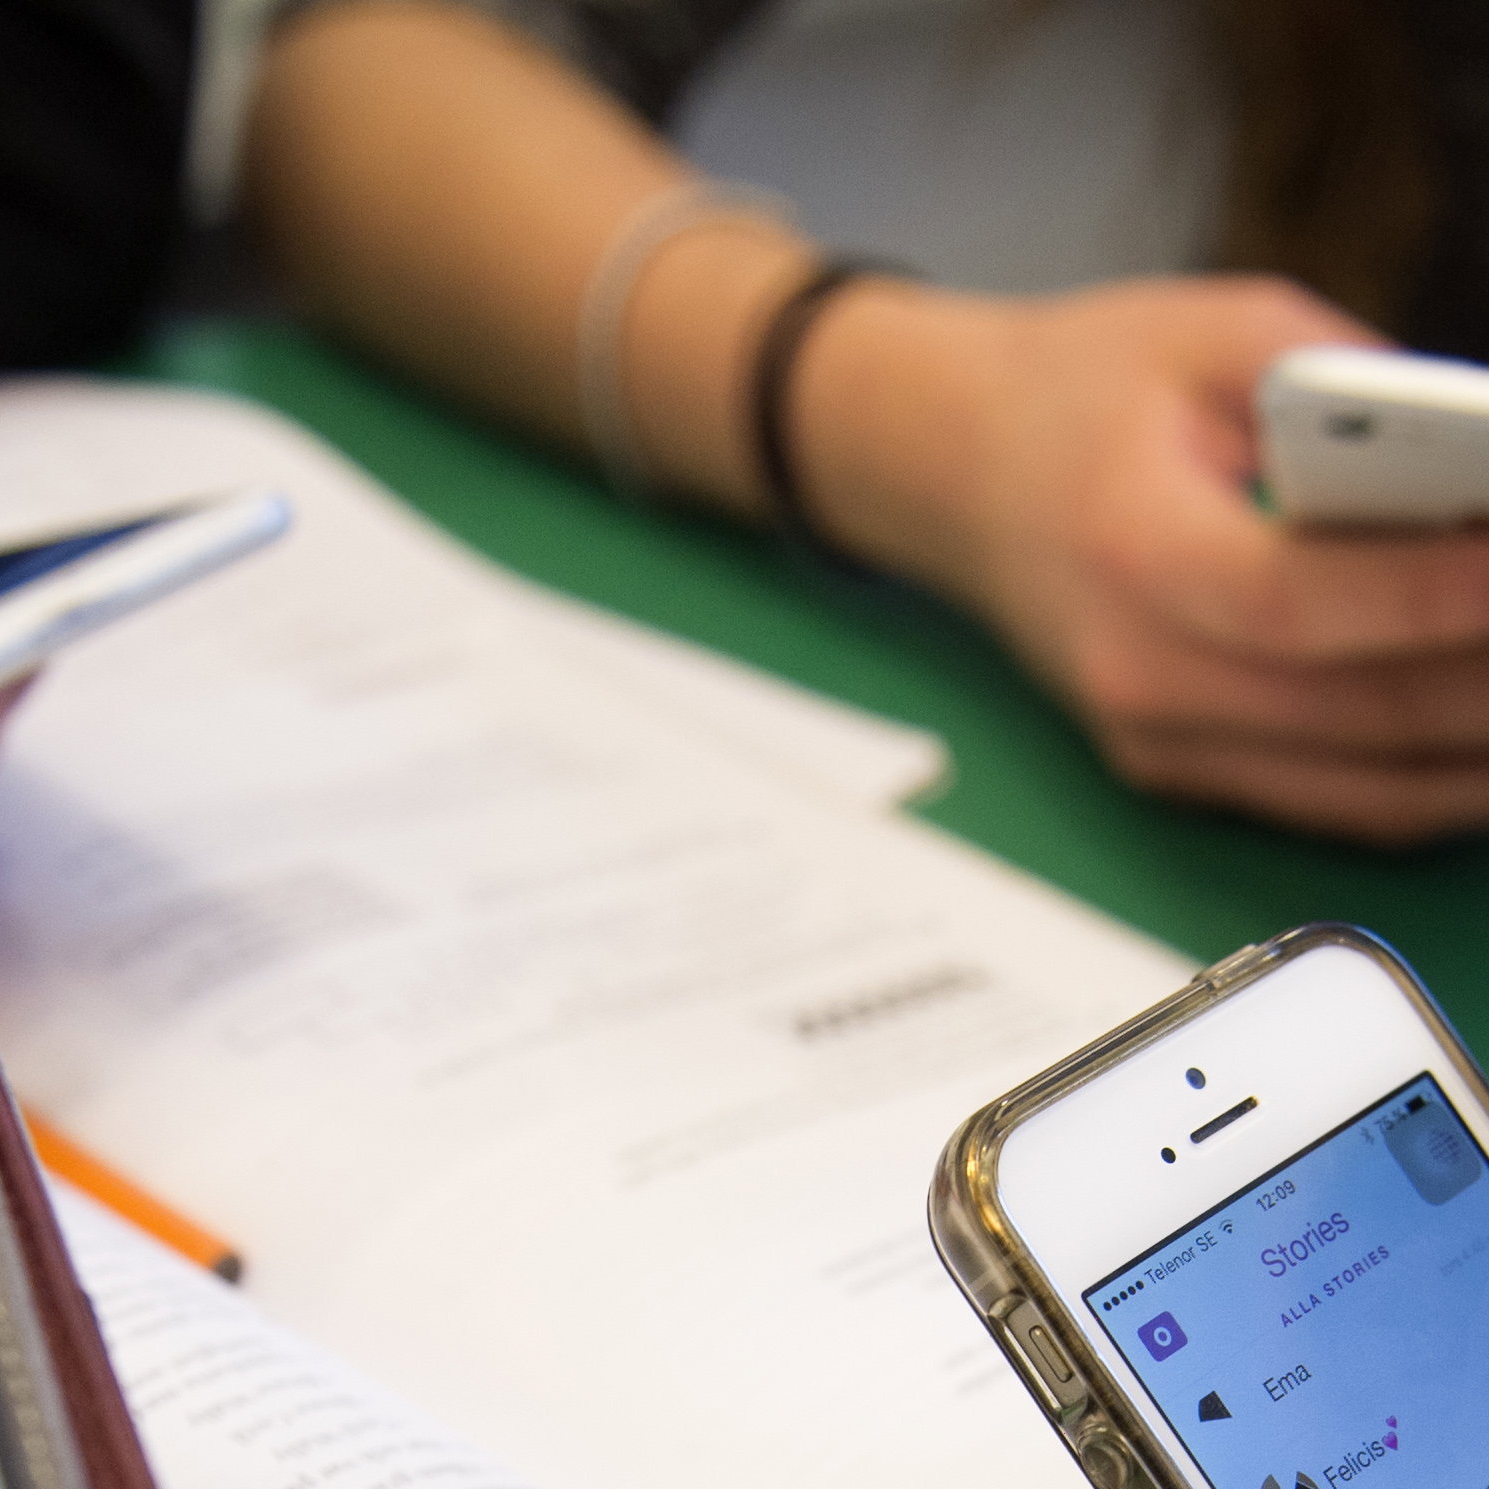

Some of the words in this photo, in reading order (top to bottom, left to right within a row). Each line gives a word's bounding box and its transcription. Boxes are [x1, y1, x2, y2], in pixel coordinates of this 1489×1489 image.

[1255, 1179, 1297, 1213] 12:09
[1144, 1243, 1198, 1286] Telenor
[1193, 1230, 1218, 1255] SE
[1260, 1211, 1351, 1279] Stories
[1279, 1292, 1323, 1329] ALLA
[1323, 1245, 1391, 1298] STORIES
[1263, 1361, 1312, 1403] Ema
